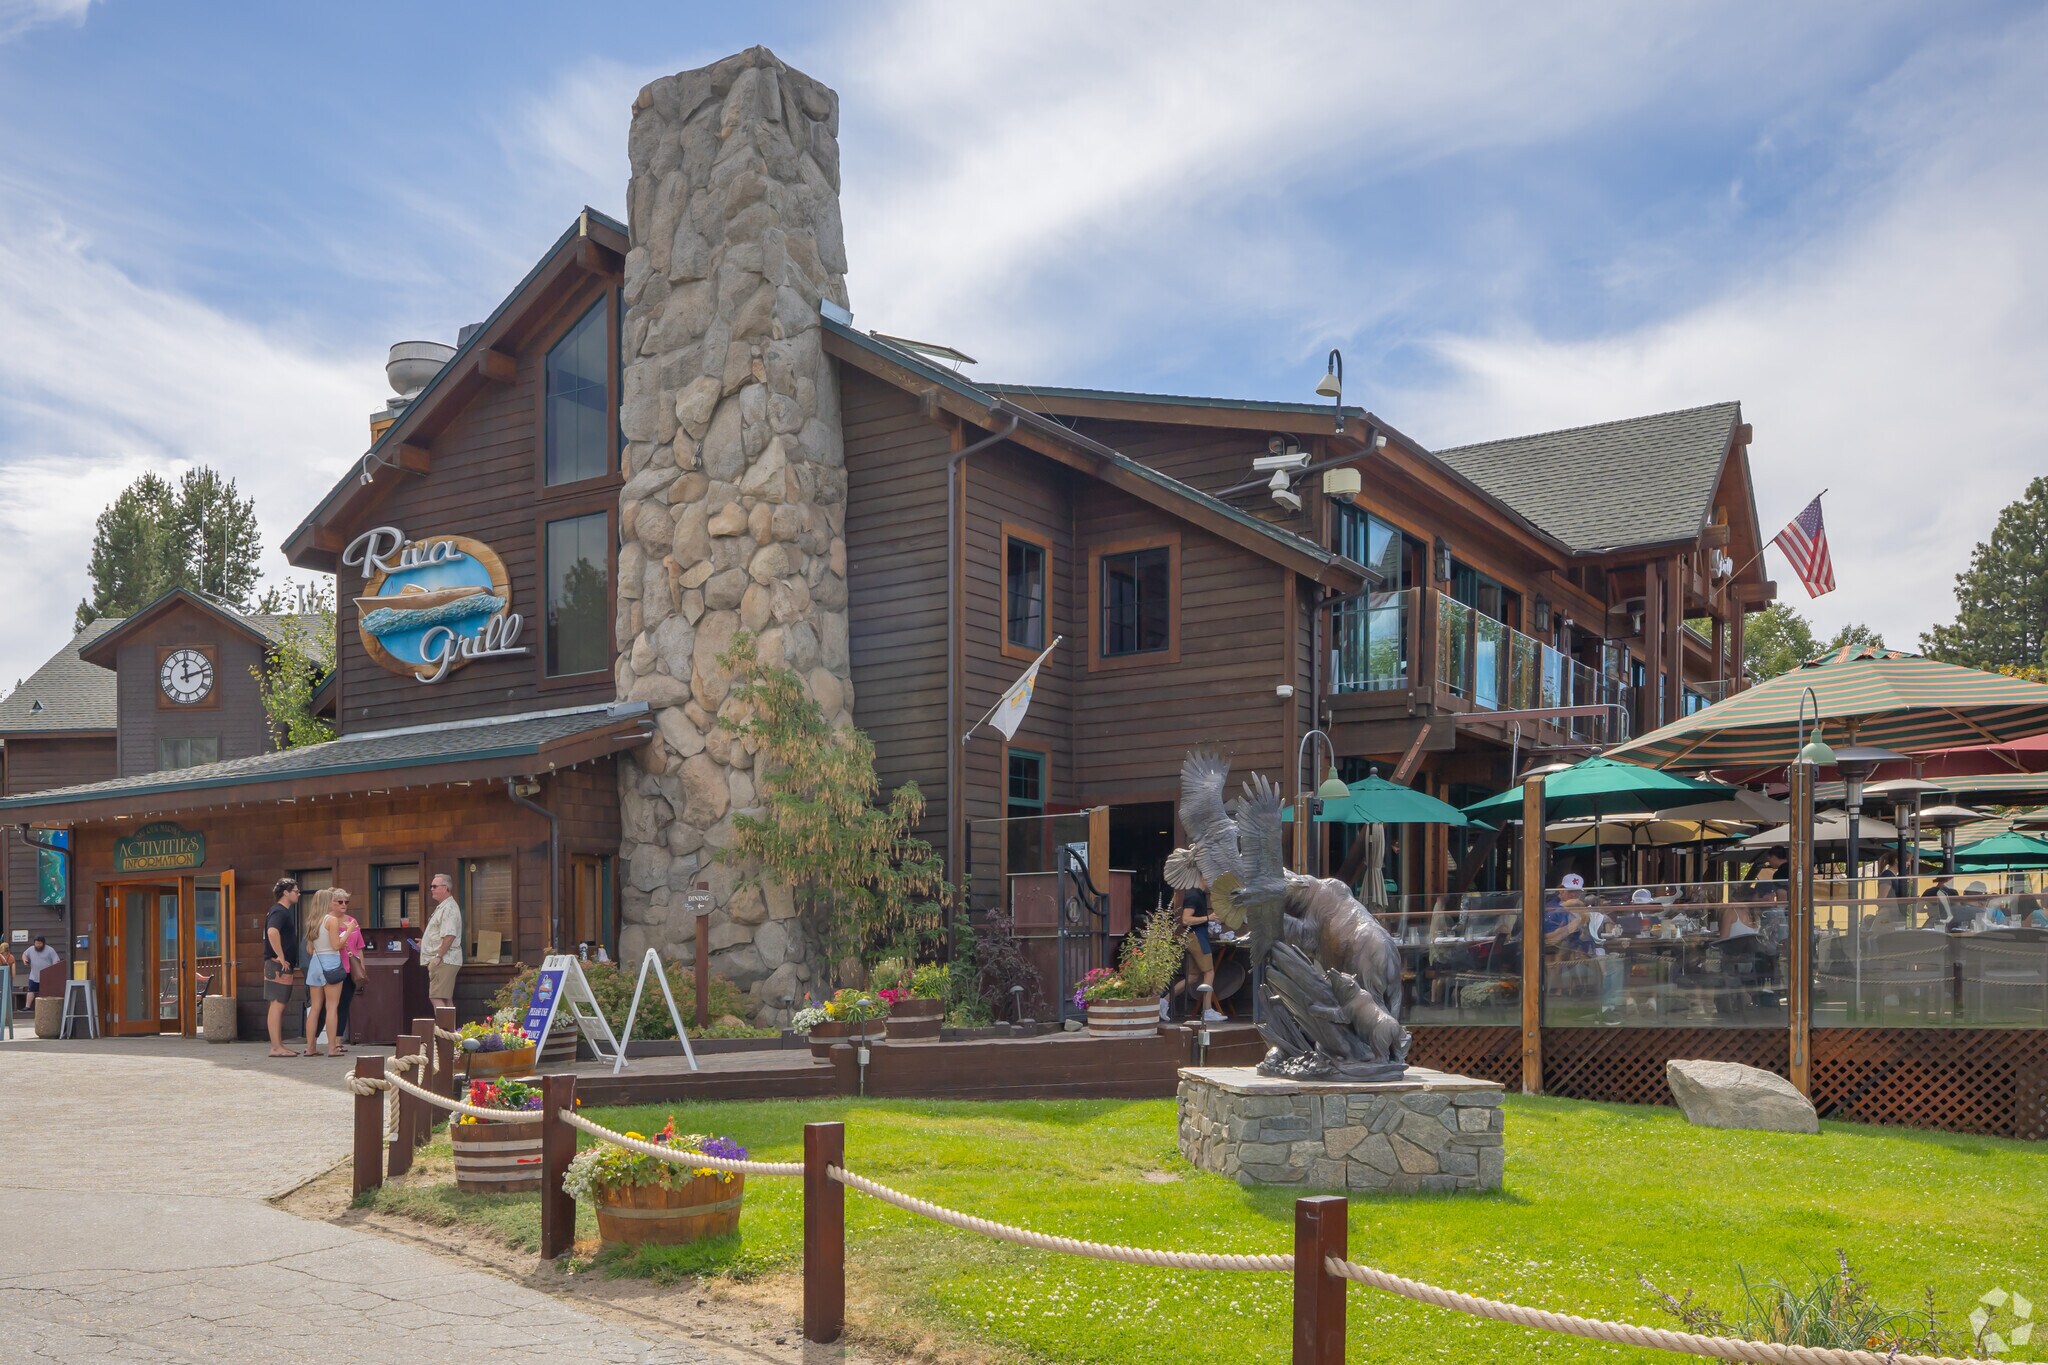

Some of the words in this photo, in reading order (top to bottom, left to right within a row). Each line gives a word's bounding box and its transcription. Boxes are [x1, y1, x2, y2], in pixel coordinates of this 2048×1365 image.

[342, 526, 464, 578] Riva
[415, 613, 530, 683] Grill
[120, 837, 199, 857] ACTIVITIES
[125, 854, 193, 868] INFORMATION
